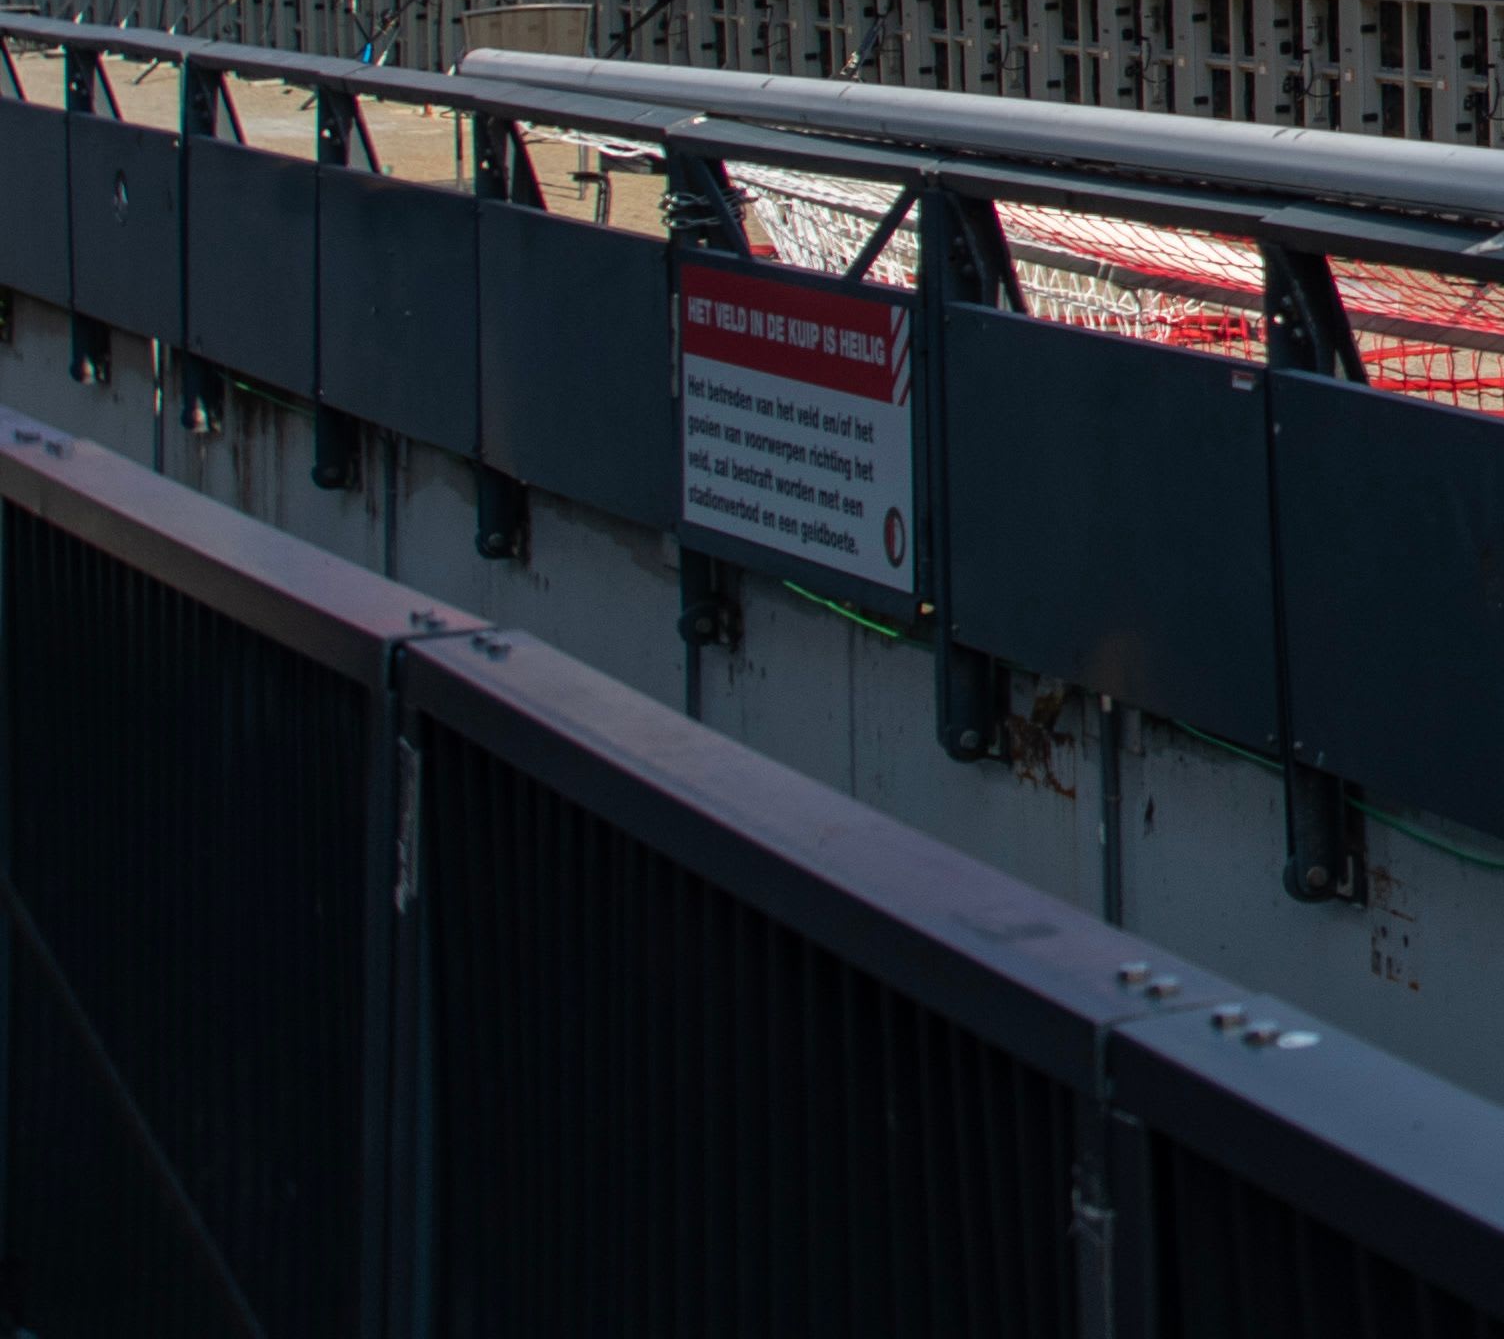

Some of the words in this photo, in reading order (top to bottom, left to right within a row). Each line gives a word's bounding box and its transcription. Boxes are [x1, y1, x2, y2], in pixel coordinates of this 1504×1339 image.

[688, 295, 712, 327] HET
[715, 301, 748, 336] VELD
[750, 309, 764, 339] IN
[767, 311, 786, 344] DE
[788, 317, 820, 351] KUIP
[823, 325, 838, 356] IS
[840, 327, 887, 367] HEILIG
[688, 374, 705, 398] Het
[707, 379, 753, 413] betreden
[756, 396, 774, 417] van
[777, 396, 795, 423] het
[797, 404, 820, 430] veld
[855, 413, 875, 444] het
[855, 453, 875, 484] het
[688, 484, 760, 525] stadionverbod
[762, 508, 777, 528] en
[778, 514, 799, 536] een
[818, 486, 840, 512] met
[842, 495, 865, 519] een
